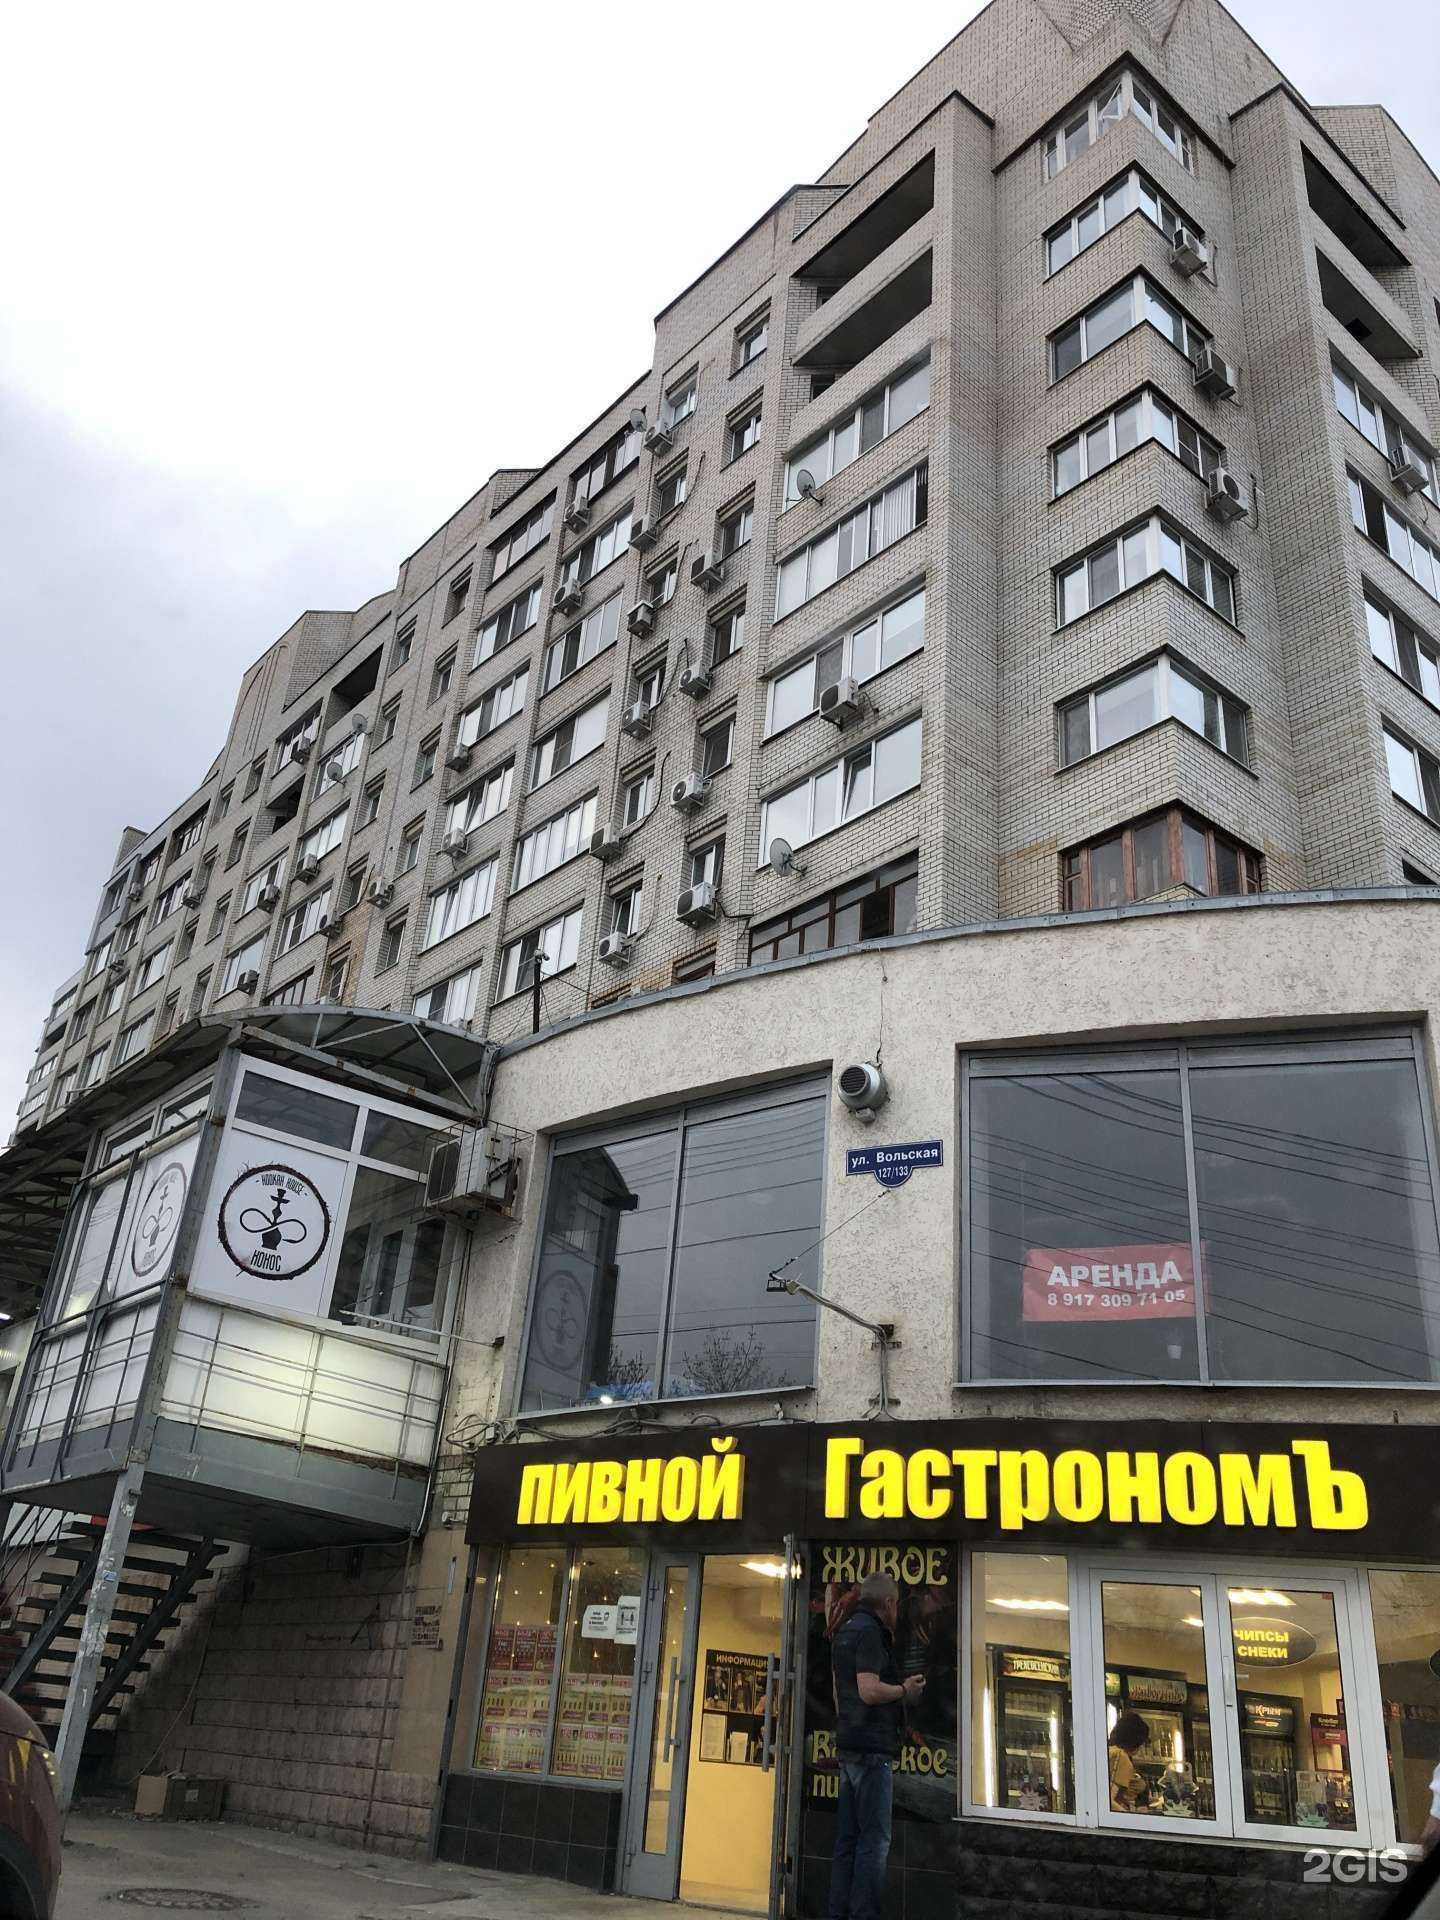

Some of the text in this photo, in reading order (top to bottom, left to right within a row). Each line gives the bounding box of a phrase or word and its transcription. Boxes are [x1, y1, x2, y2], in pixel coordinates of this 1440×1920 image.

[851, 1148, 939, 1169] ул. Вольская
[878, 1166, 909, 1178] 127/133
[261, 1174, 304, 1195] HOOKAH HOUSE
[1047, 1260, 1183, 1290] АРЕНДА
[1047, 1289, 1185, 1307] 8 917 309 71 05
[824, 1437, 1369, 1531] ГастрономЪ
[1234, 1629, 1289, 1642] ЧИПСЫ
[716, 1653, 769, 1668] ИНФОРМАЦИ
[1237, 1645, 1288, 1658] СНЕКИ
